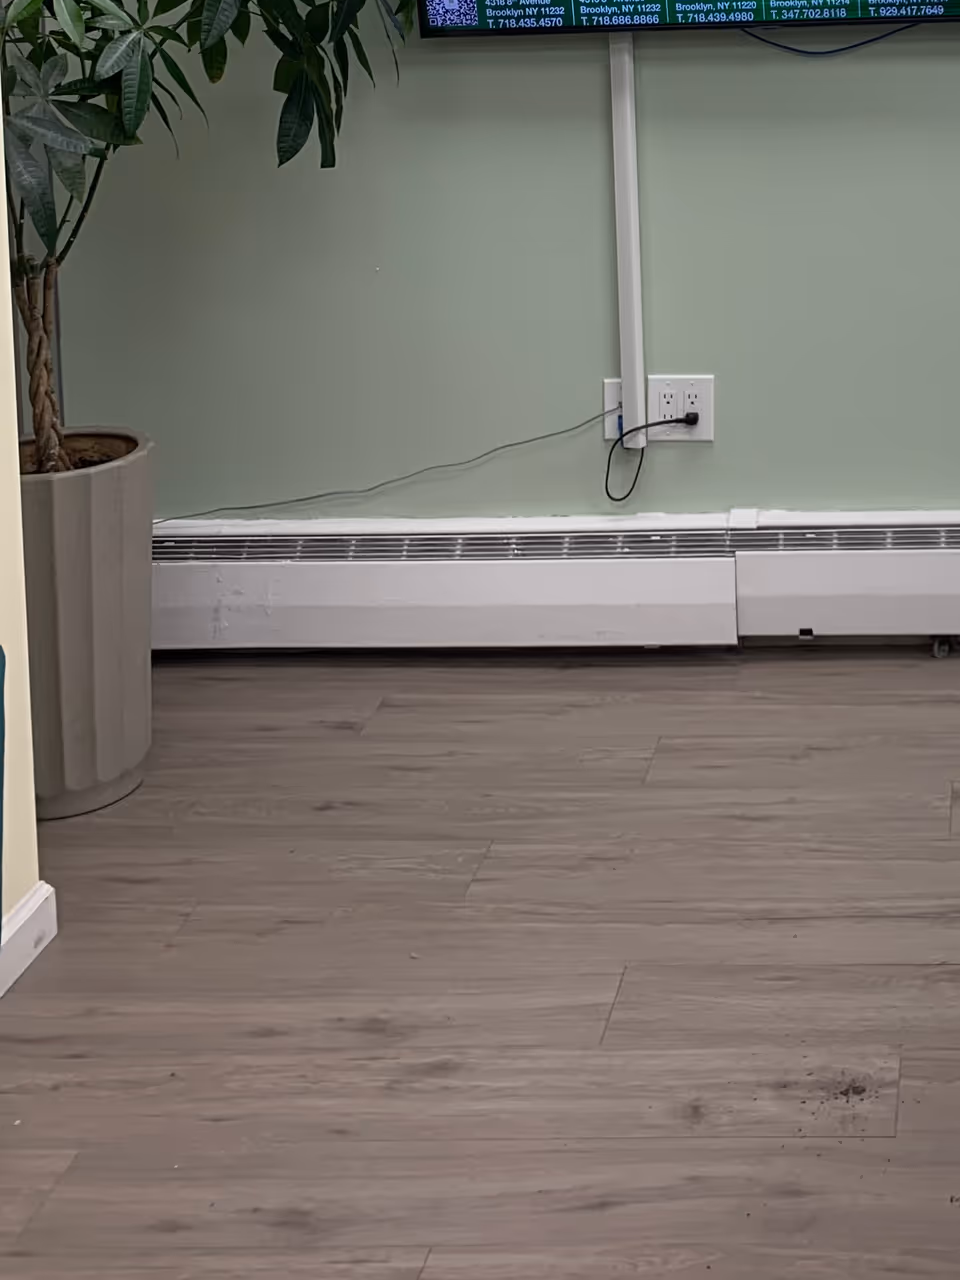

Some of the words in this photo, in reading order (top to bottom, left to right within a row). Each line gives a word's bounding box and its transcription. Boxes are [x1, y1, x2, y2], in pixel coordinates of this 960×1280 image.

[486, 8, 524, 17] Brooklyn
[525, 7, 538, 16] NY
[541, 6, 565, 15] 11232
[580, 5, 620, 15] Brooklyn,
[622, 4, 635, 12] NY
[638, 3, 661, 12] 11232
[675, 2, 716, 12] Brooklyn,
[718, 1, 730, 10] NY
[733, 1, 757, 9] 11220
[868, 7, 878, 17] T.
[676, 13, 685, 23] T.
[687, 12, 754, 22] 718.439.4980
[770, 10, 780, 20] T.
[781, 8, 847, 19] 347.702.8118
[487, 19, 497, 29] T.
[499, 17, 563, 28] 718.435.4570
[581, 16, 590, 26] T.
[592, 14, 660, 25] 718.686.8866
